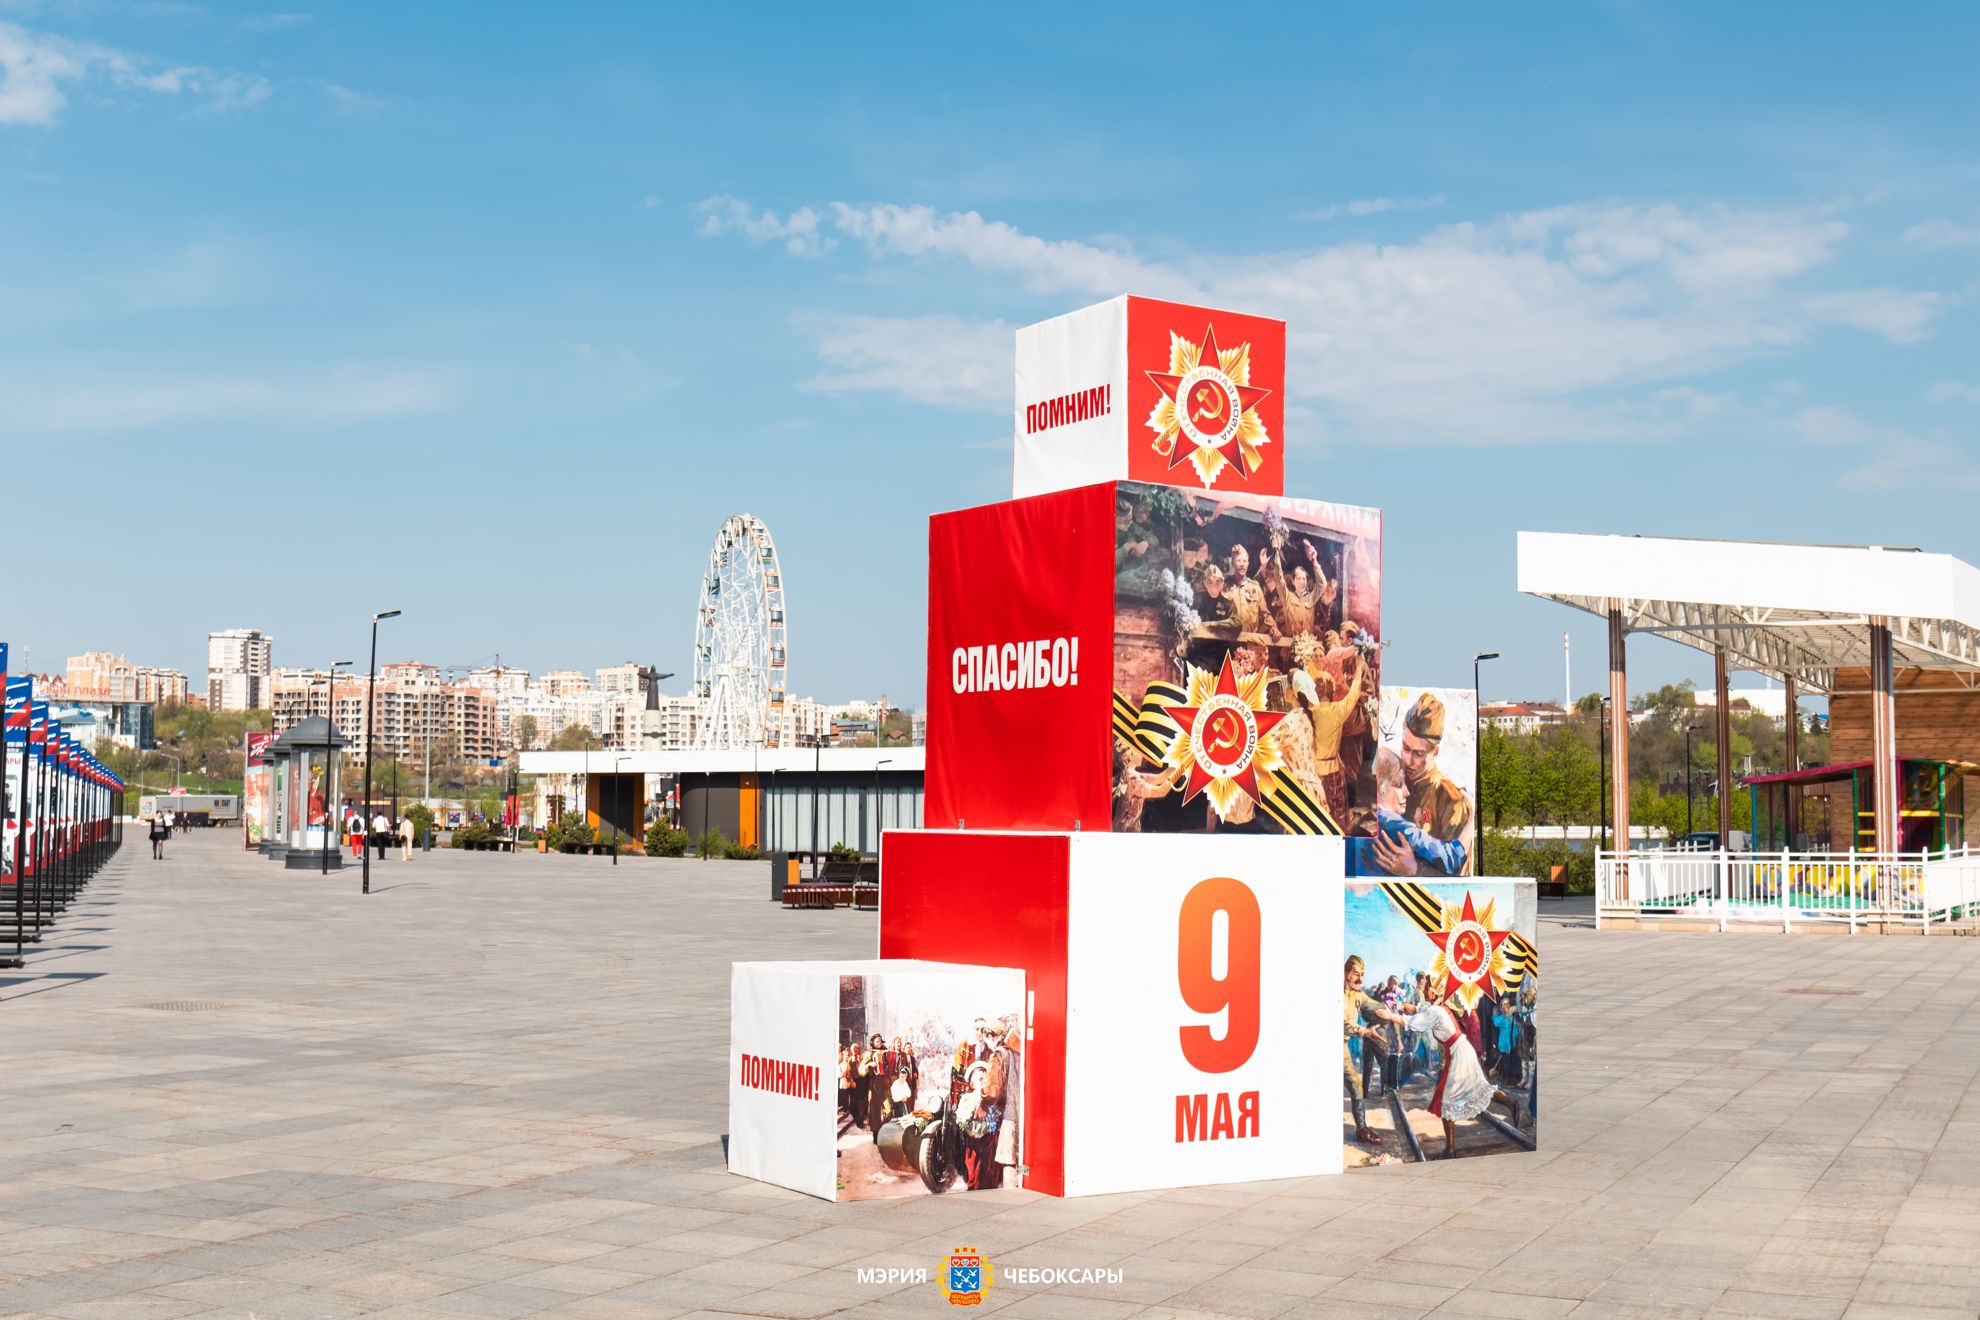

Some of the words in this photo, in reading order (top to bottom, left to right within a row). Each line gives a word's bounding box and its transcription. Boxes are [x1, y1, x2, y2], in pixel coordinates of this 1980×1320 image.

[1026, 383, 1111, 434] ПОМНИМ!
[952, 637, 1079, 694] СПАСИБО!
[1178, 876, 1262, 1074] 9
[740, 1053, 820, 1101] ПОМНИМ!
[1174, 1090, 1260, 1143] МАЯ
